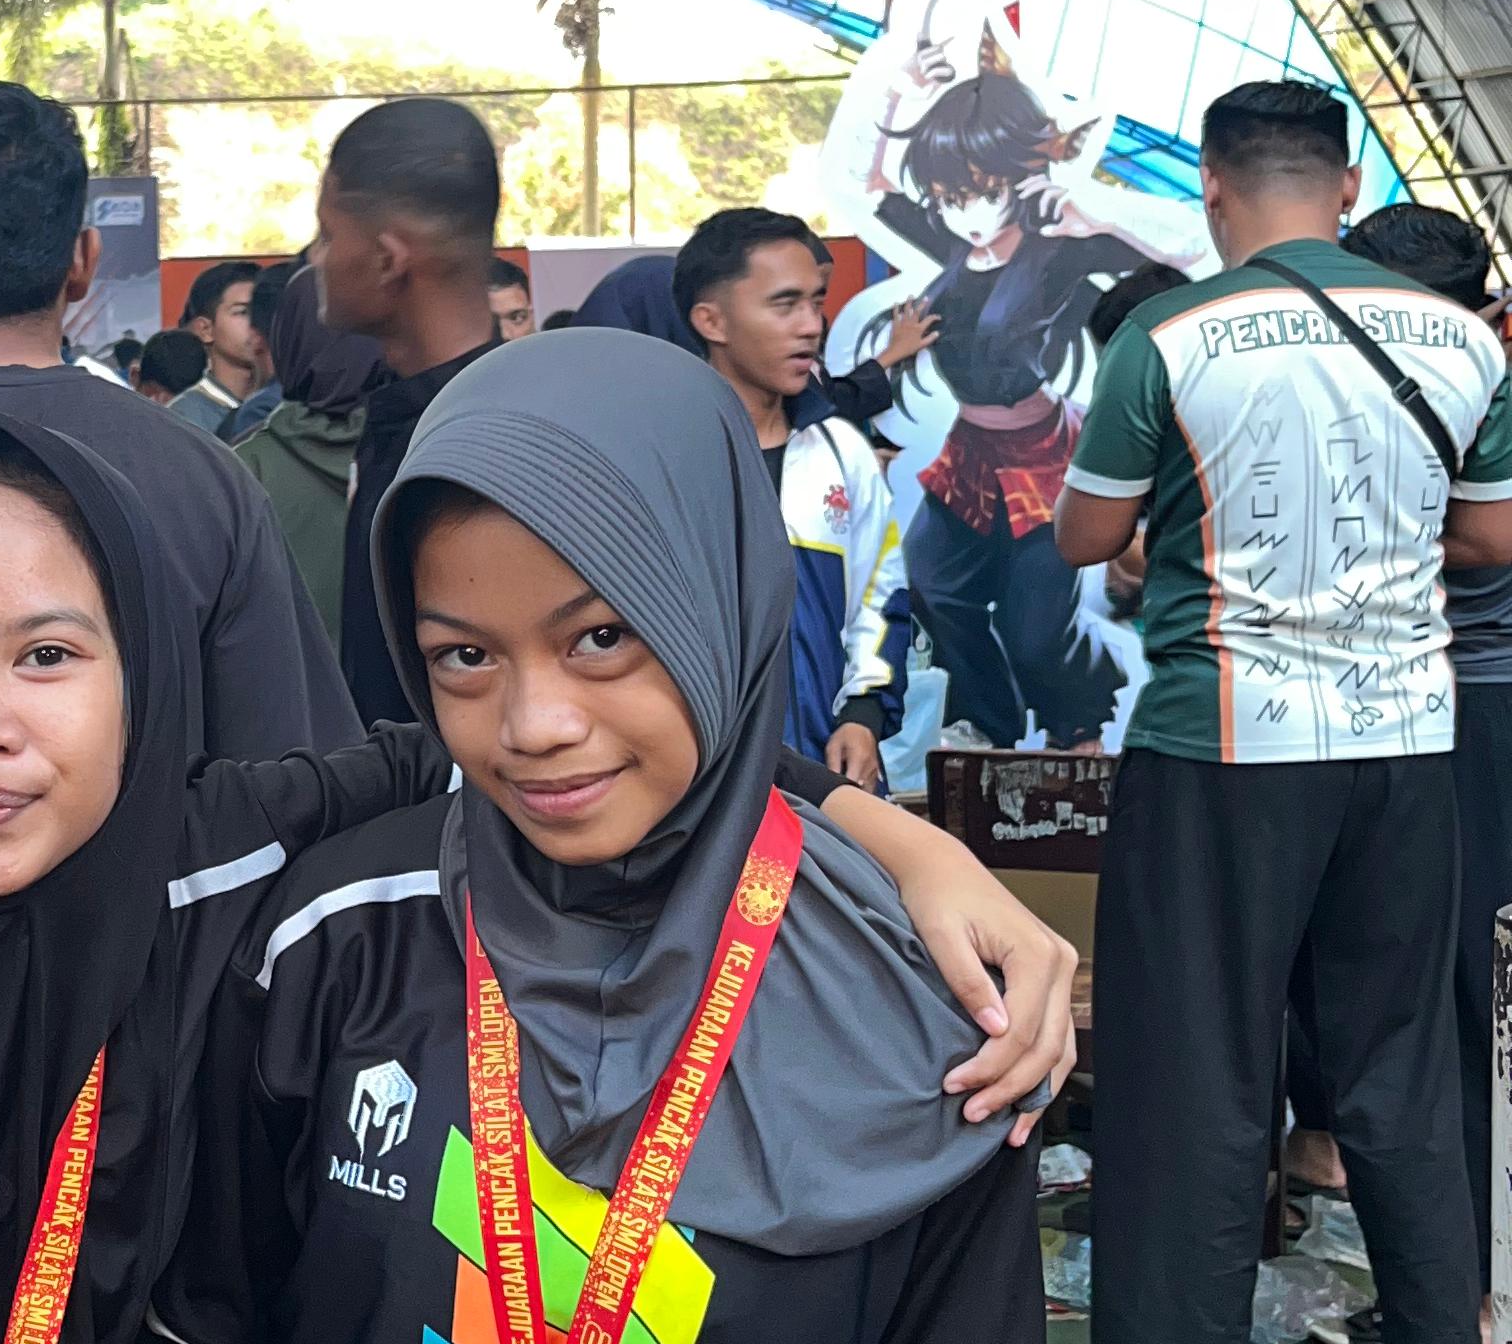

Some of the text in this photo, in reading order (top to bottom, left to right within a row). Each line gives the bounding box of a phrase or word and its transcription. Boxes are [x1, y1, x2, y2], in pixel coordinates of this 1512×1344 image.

[1358, 303, 1468, 349] SILAT
[479, 978, 505, 1033] OPEN
[686, 939, 756, 1065] KEJUARAAN
[481, 1038, 508, 1078] SMI
[483, 1084, 513, 1145] SILAT
[651, 1063, 707, 1154] PENCAK
[51, 1147, 88, 1230] PENCAK
[329, 1154, 407, 1202] MILLS
[489, 1151, 522, 1236] PENCAK
[630, 1149, 672, 1215] SILAT
[36, 1232, 71, 1291] SILAT
[613, 1211, 647, 1260] SMI
[24, 1291, 55, 1332] SMI
[594, 1254, 632, 1314] OPEN
